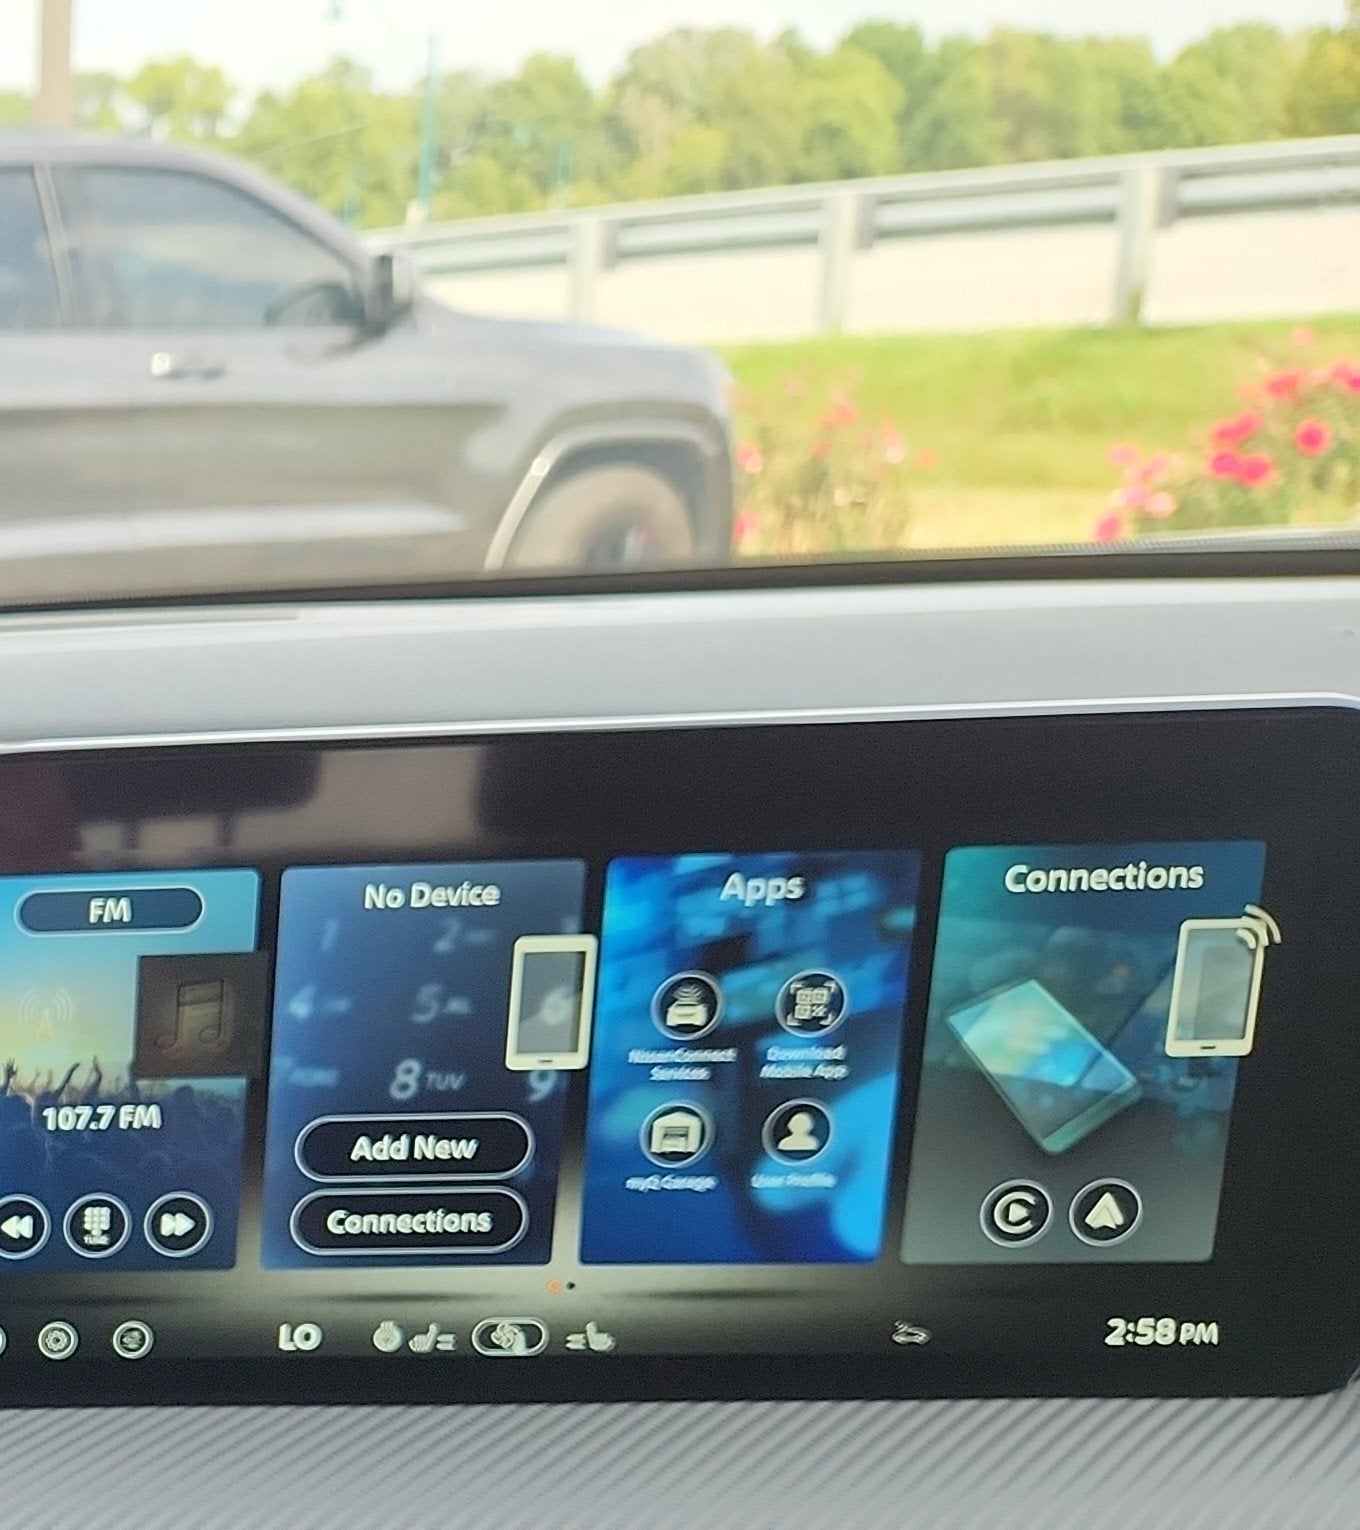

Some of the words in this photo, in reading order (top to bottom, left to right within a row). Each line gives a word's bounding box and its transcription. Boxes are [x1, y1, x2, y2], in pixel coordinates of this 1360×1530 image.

[719, 872, 805, 907] Apps
[1004, 862, 1205, 893] Connections
[365, 884, 405, 910] No
[410, 880, 502, 908] Device
[88, 897, 132, 924] FM
[42, 1105, 114, 1132] 107.7
[118, 1104, 162, 1130] FM
[350, 1135, 410, 1161] Add
[413, 1134, 479, 1160] New
[326, 1208, 493, 1235] Connections
[278, 1322, 323, 1352] LO
[1104, 1317, 1178, 1346] 2:58
[1179, 1321, 1219, 1346] PM
